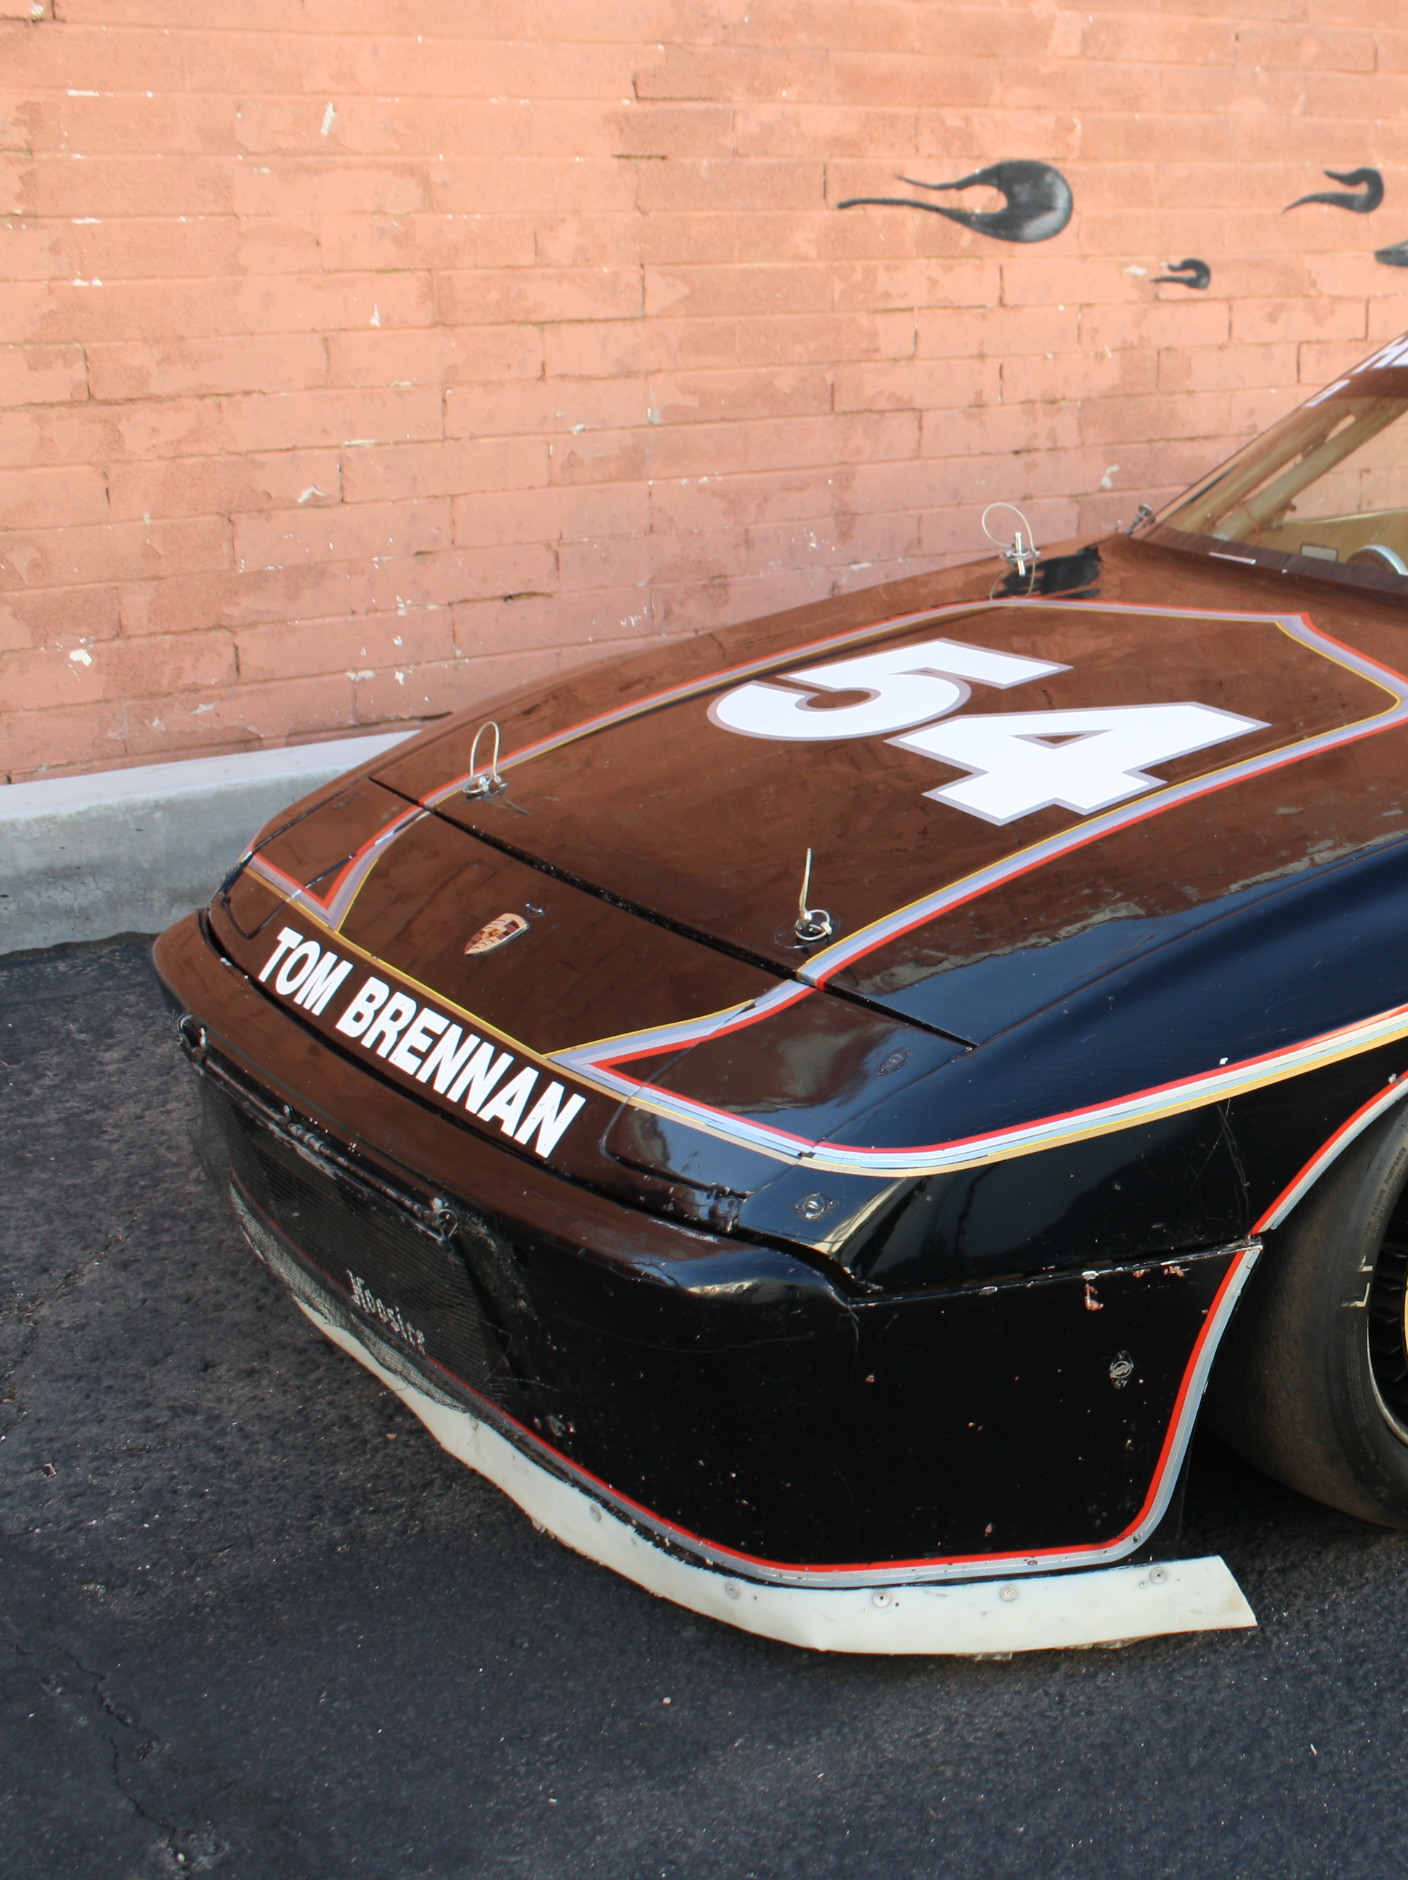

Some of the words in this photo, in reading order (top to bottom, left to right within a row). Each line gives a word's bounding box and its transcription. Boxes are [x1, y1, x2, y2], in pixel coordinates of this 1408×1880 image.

[706, 637, 1273, 827] 54
[257, 926, 353, 1017] TOM
[335, 975, 587, 1159] BRENNAN
